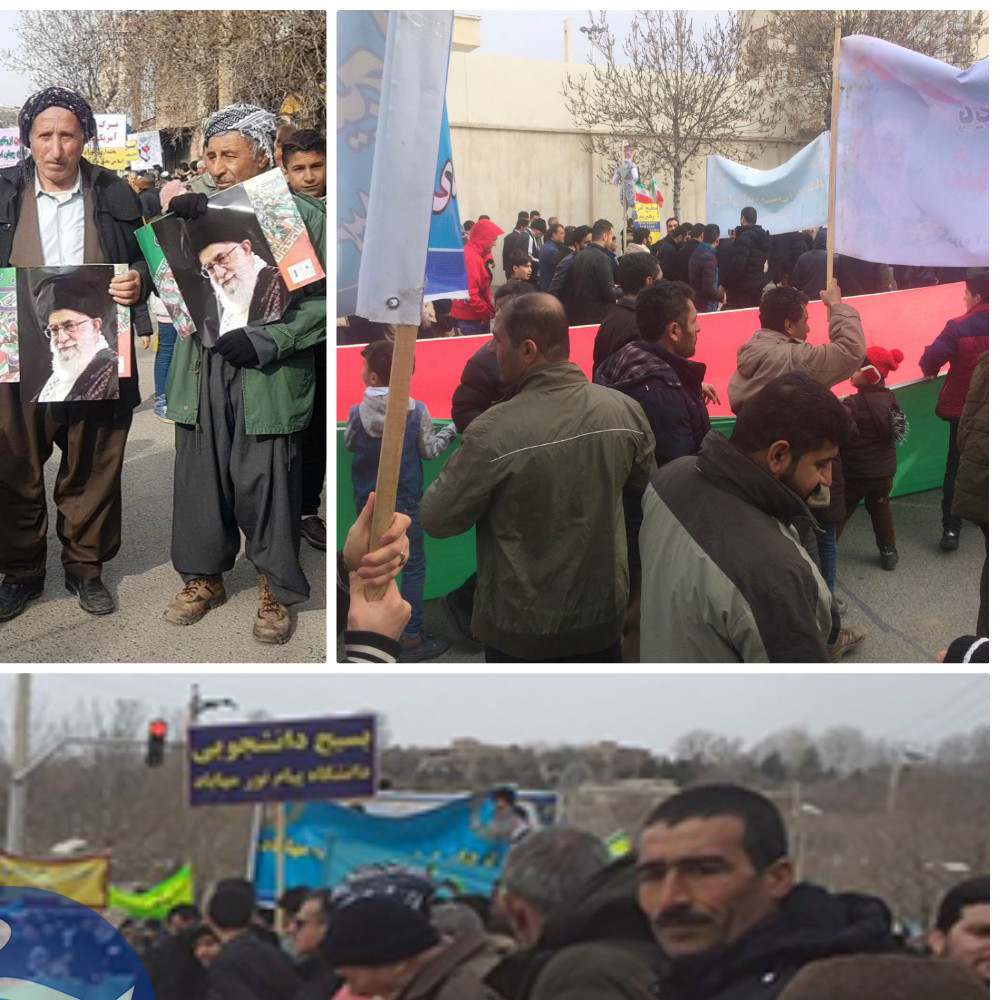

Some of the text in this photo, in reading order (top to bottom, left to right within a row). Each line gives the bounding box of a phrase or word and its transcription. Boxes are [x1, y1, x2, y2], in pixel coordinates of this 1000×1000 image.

[193, 728, 370, 764] بسیج دانشجویی
[194, 764, 370, 791] دانشگاه پیام نور مهاباد
